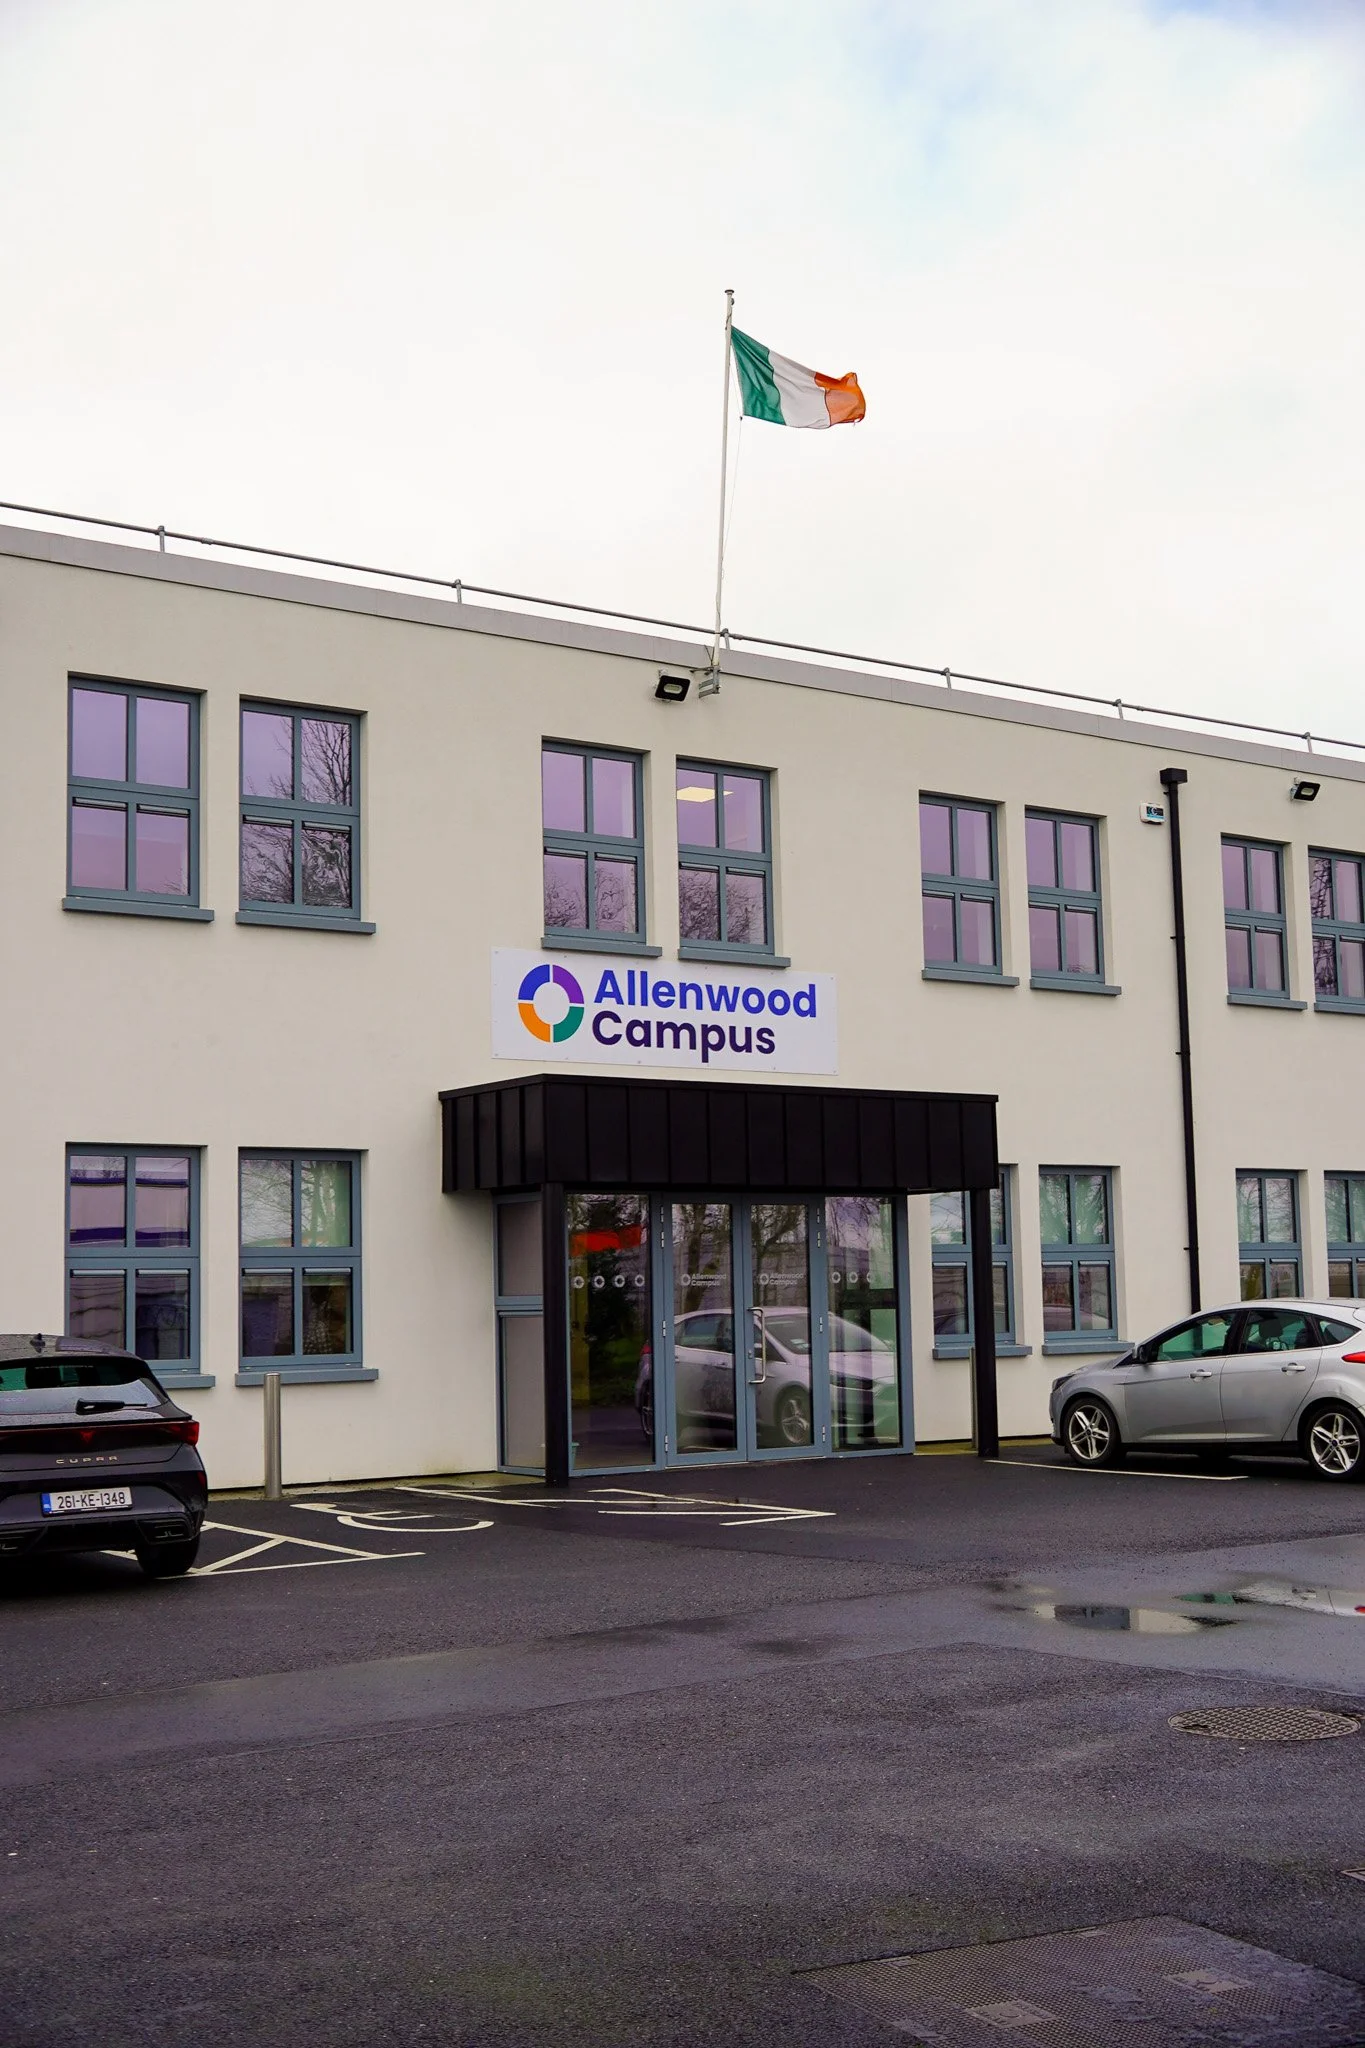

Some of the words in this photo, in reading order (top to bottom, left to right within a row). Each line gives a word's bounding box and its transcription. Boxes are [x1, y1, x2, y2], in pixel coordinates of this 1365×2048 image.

[594, 969, 817, 1018] Allenwood
[592, 1010, 776, 1063] Campus
[691, 1280, 721, 1288] Campus
[56, 1455, 118, 1464] CUPRA
[57, 1491, 126, 1509] 261-KE-1348
